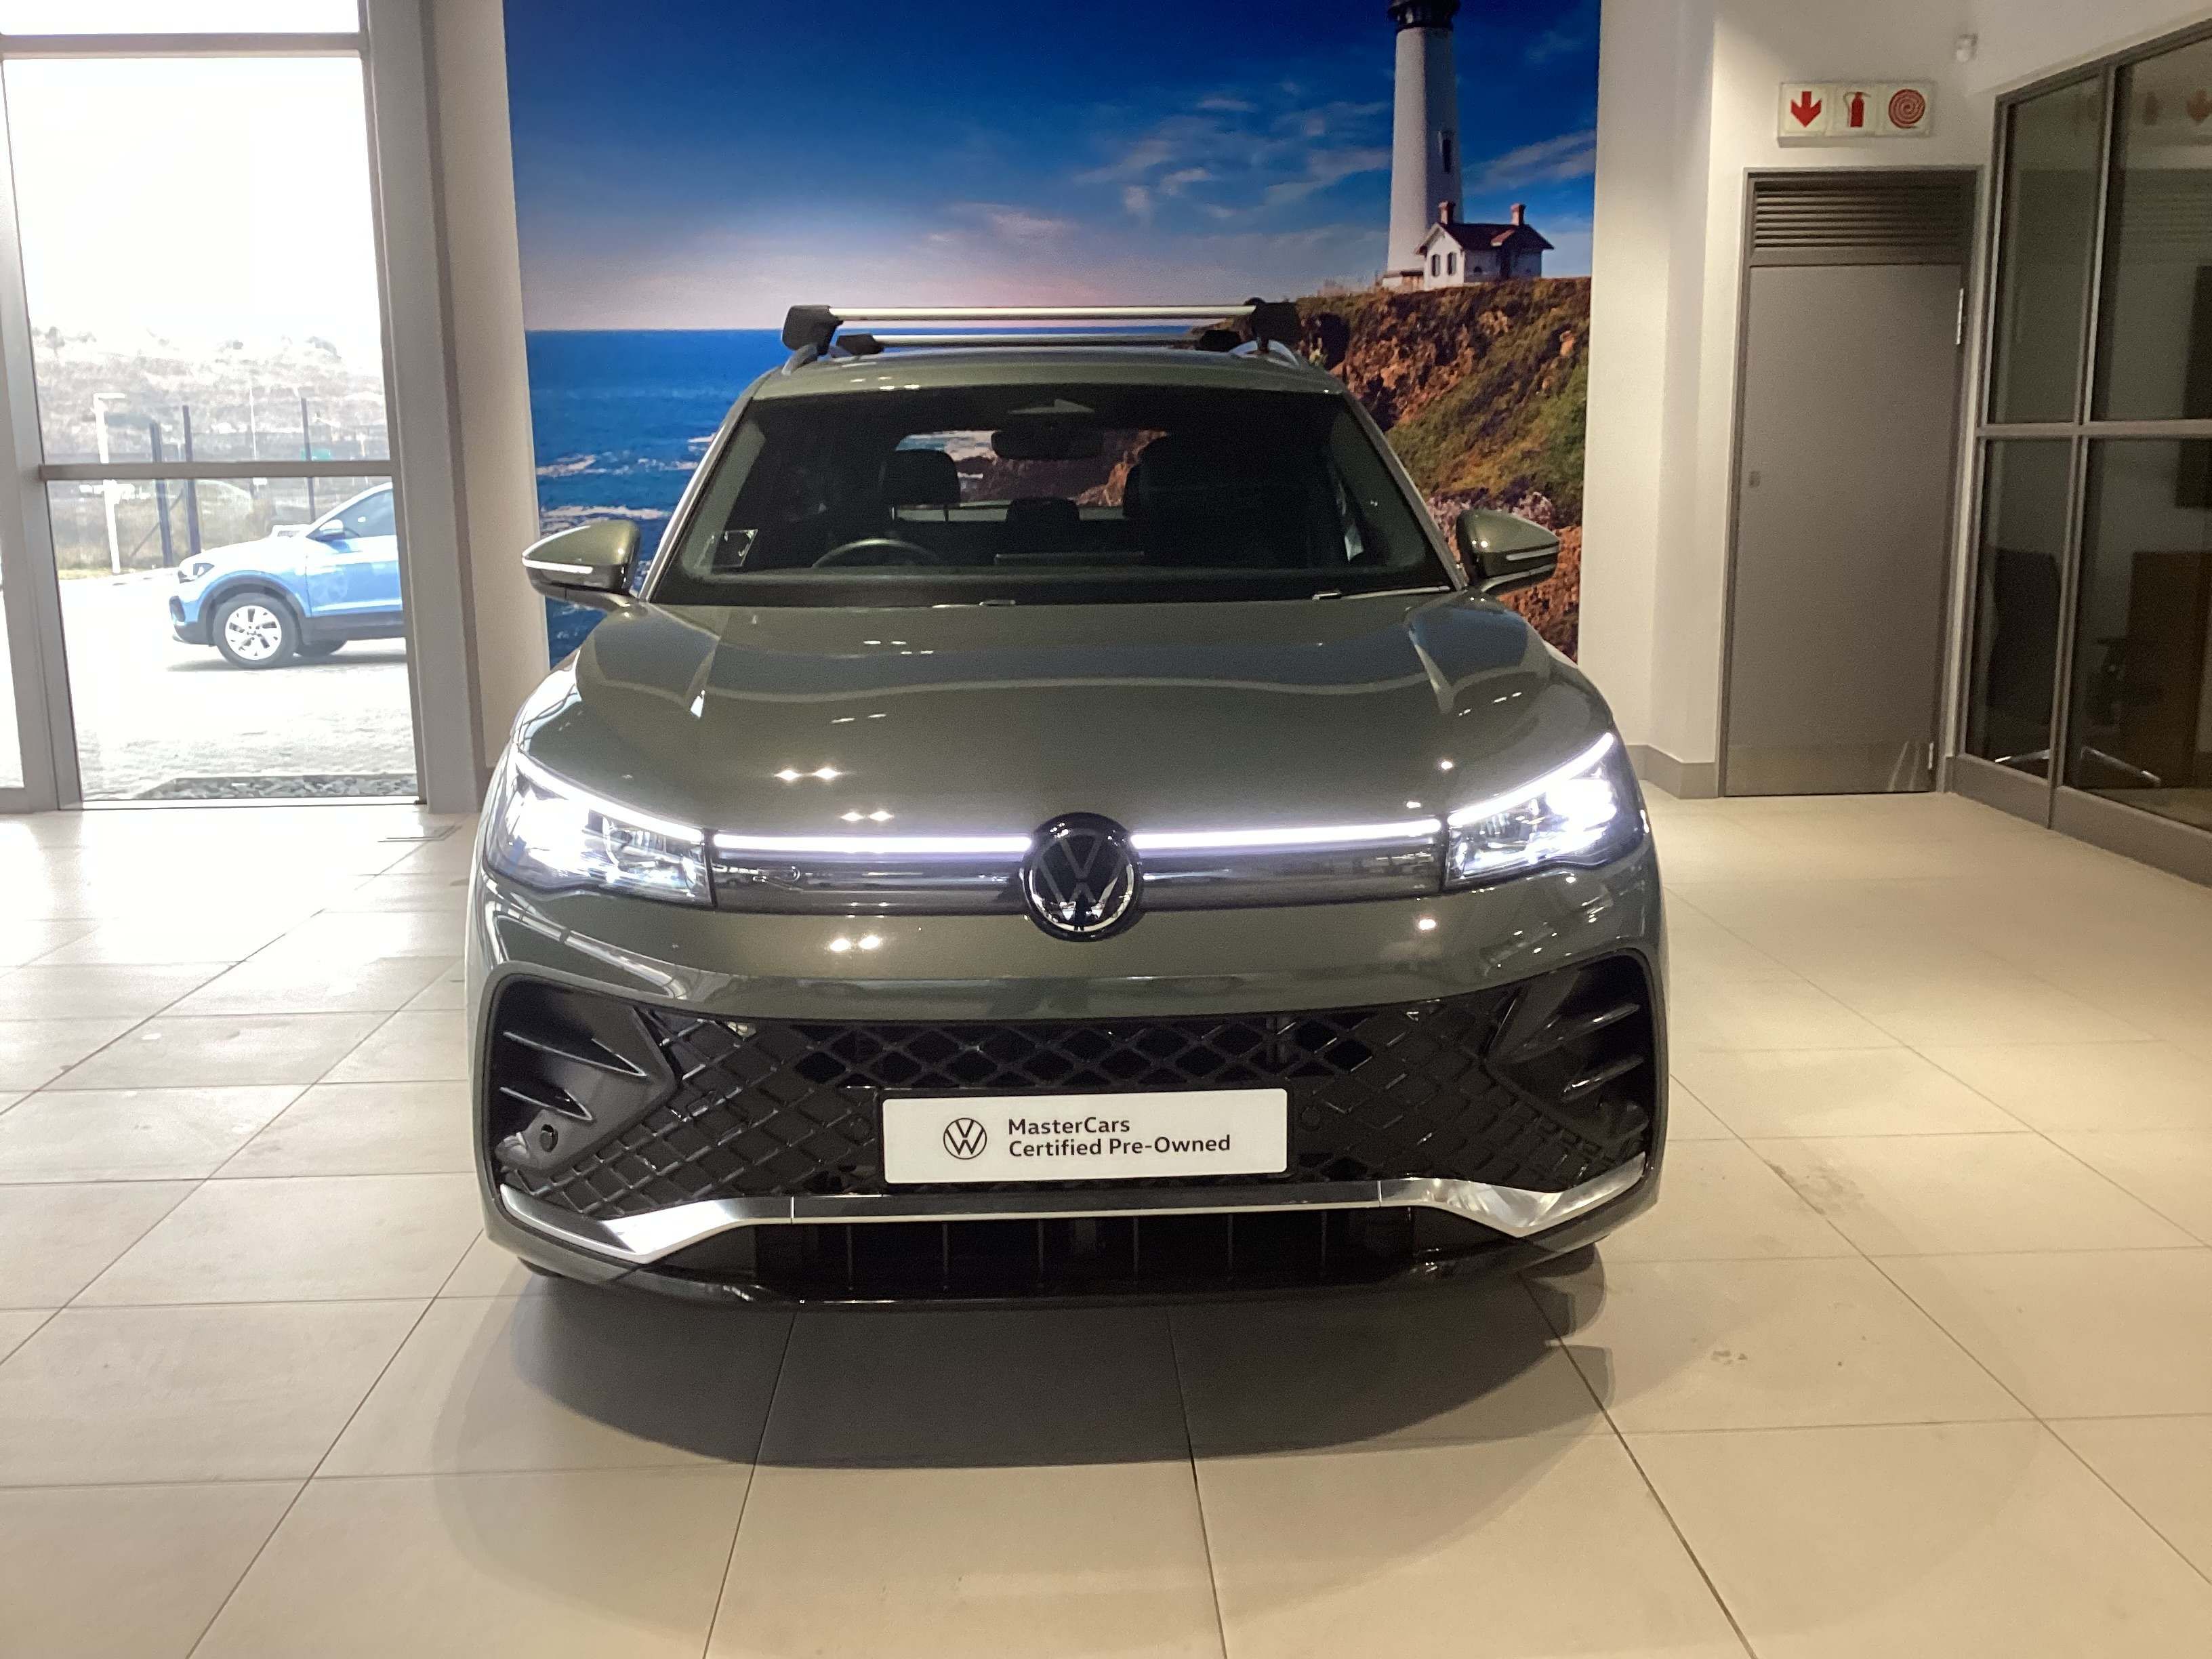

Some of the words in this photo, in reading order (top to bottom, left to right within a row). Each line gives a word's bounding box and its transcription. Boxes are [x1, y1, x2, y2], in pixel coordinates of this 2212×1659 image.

[1029, 828, 1134, 931] VW
[943, 1118, 987, 1160] VW
[1008, 1116, 1130, 1135] MasterCars
[1009, 1138, 1101, 1157] Certified
[1109, 1134, 1231, 1155] Pre-Owned
